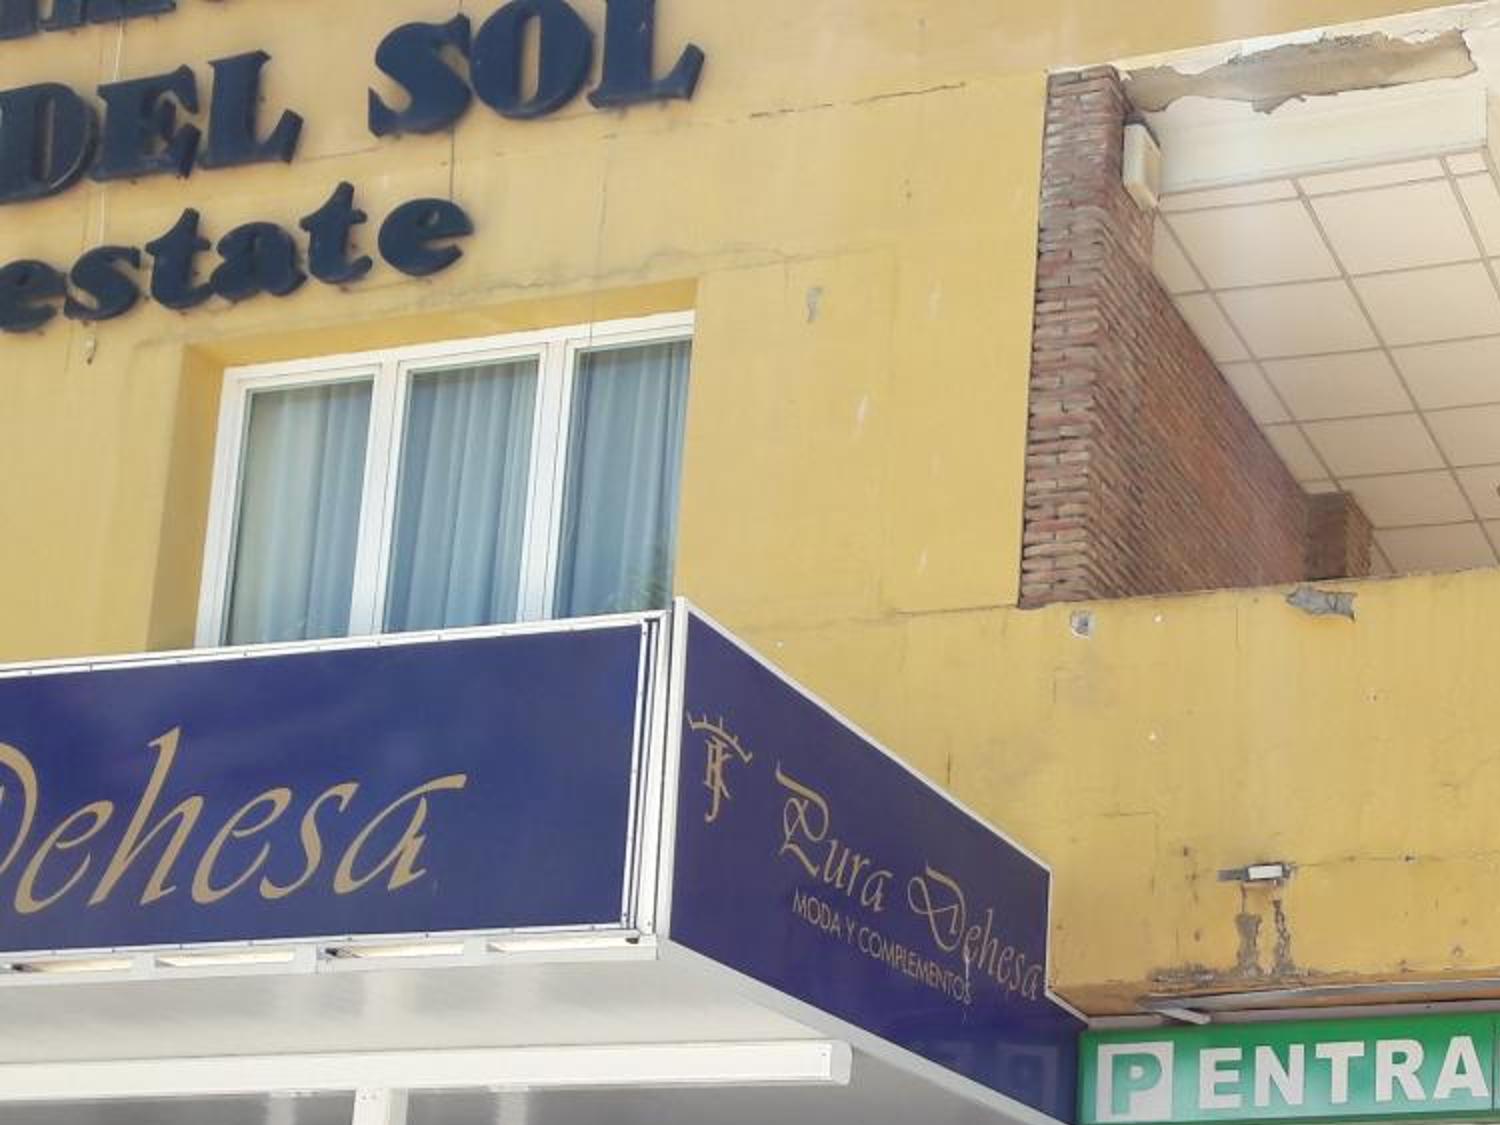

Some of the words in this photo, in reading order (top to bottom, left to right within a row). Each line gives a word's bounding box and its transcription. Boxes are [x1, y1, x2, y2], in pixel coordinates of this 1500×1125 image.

[0, 51, 303, 203] DEL
[368, 0, 705, 138] SOL
[0, 182, 474, 332] estate
[776, 762, 893, 912] Pura
[907, 861, 1043, 1000] Dehesa
[793, 888, 842, 938] MODA
[845, 916, 856, 945] Y
[858, 926, 973, 1005] COMPLEMENTOS
[1112, 1052, 1161, 1115] P
